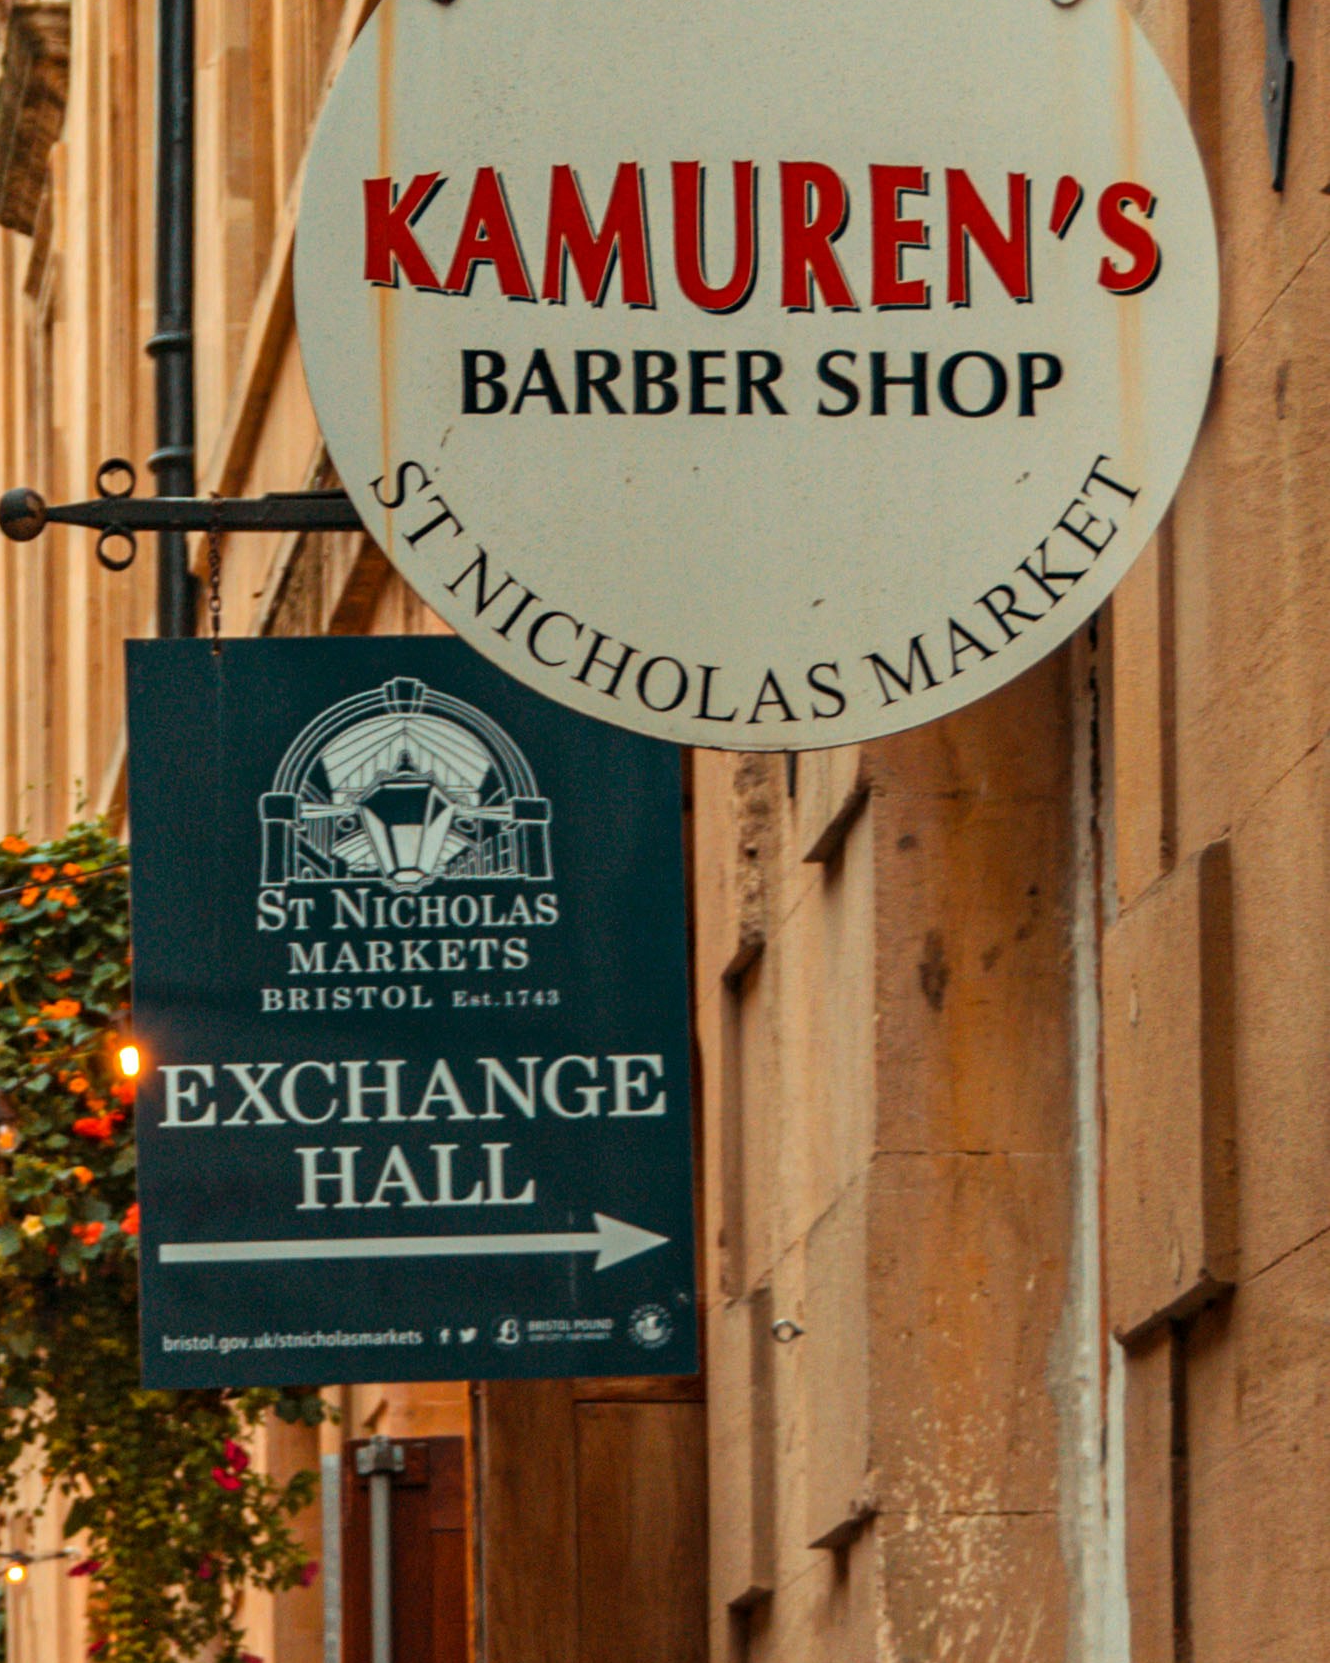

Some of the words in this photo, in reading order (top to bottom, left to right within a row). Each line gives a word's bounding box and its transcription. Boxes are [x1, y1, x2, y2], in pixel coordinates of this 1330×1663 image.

[361, 158, 1162, 315] KAMUREN'S
[460, 349, 790, 418] BARBER
[817, 350, 1065, 419] SHOP
[370, 456, 465, 550] ST
[445, 546, 848, 728] NICHOLAS
[863, 452, 1141, 711] MARKET
[286, 936, 530, 976] MARKETS
[260, 984, 434, 1013] BRISTOL
[156, 1053, 668, 1129] EXCHANGE
[294, 1142, 536, 1211] HALL
[162, 1327, 424, 1355] bristol.gov.uk/stnicholasmarkets
